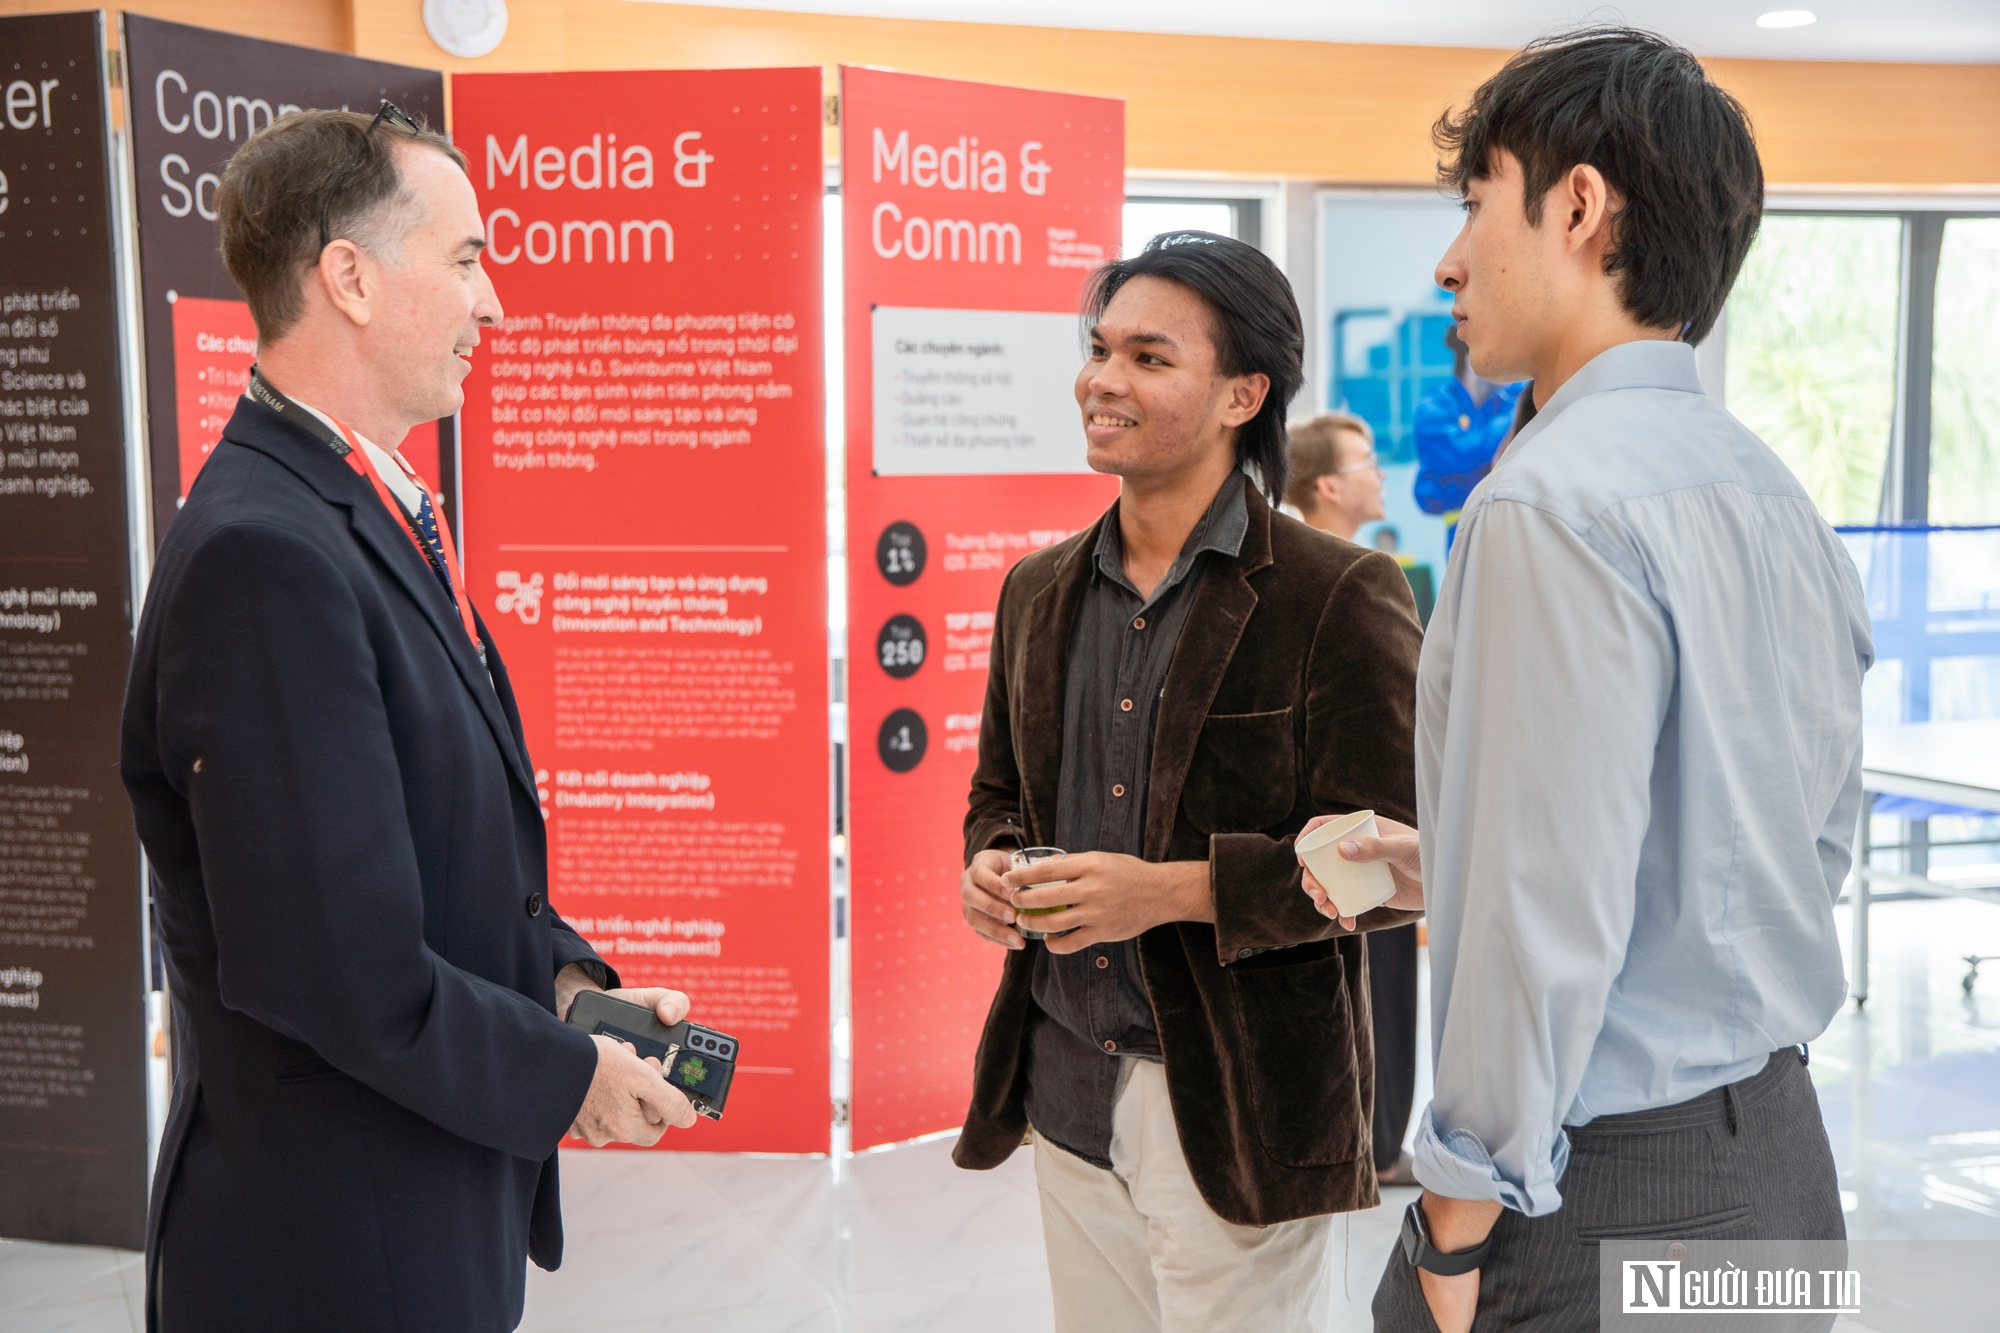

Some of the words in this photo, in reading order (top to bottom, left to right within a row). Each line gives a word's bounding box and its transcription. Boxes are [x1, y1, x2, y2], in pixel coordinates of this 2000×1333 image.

[485, 133, 654, 191] Media
[673, 130, 715, 188] &
[872, 127, 1007, 193] Media
[1018, 140, 1052, 196] &
[485, 207, 674, 265] Comm
[872, 201, 1022, 265] Comm
[3, 290, 40, 316] phát
[544, 312, 600, 335] Truyền
[601, 313, 649, 335] thông
[690, 337, 736, 357] trong
[2, 370, 65, 390] Science
[66, 370, 86, 390] và
[490, 360, 532, 381] công
[532, 360, 574, 381] nghệ
[575, 359, 608, 377] 4.0.
[608, 358, 696, 378] Swinburne
[697, 357, 732, 380] Việt
[733, 358, 773, 377] Nam
[528, 383, 559, 401] các
[701, 381, 754, 404] phong
[26, 396, 58, 420] biệt
[59, 395, 89, 416] của
[4, 421, 38, 446] Việt
[39, 422, 76, 442] Nam
[535, 427, 576, 450] công
[577, 427, 619, 450] nghệ
[652, 428, 699, 450] trong
[39, 448, 79, 471] nhọn
[36, 474, 94, 498] nghiệp.
[886, 547, 915, 573] 1%
[60, 587, 97, 610] nhọn
[552, 613, 638, 633] (Innovation
[638, 614, 669, 633] and
[669, 614, 763, 637] Technology)
[882, 638, 924, 667] 250
[609, 770, 658, 788] doanh
[658, 770, 711, 792] nghiệp
[554, 789, 624, 812] (Industry
[624, 790, 715, 812] Integration)
[672, 917, 726, 938] nghiệp
[615, 936, 721, 958] Development)
